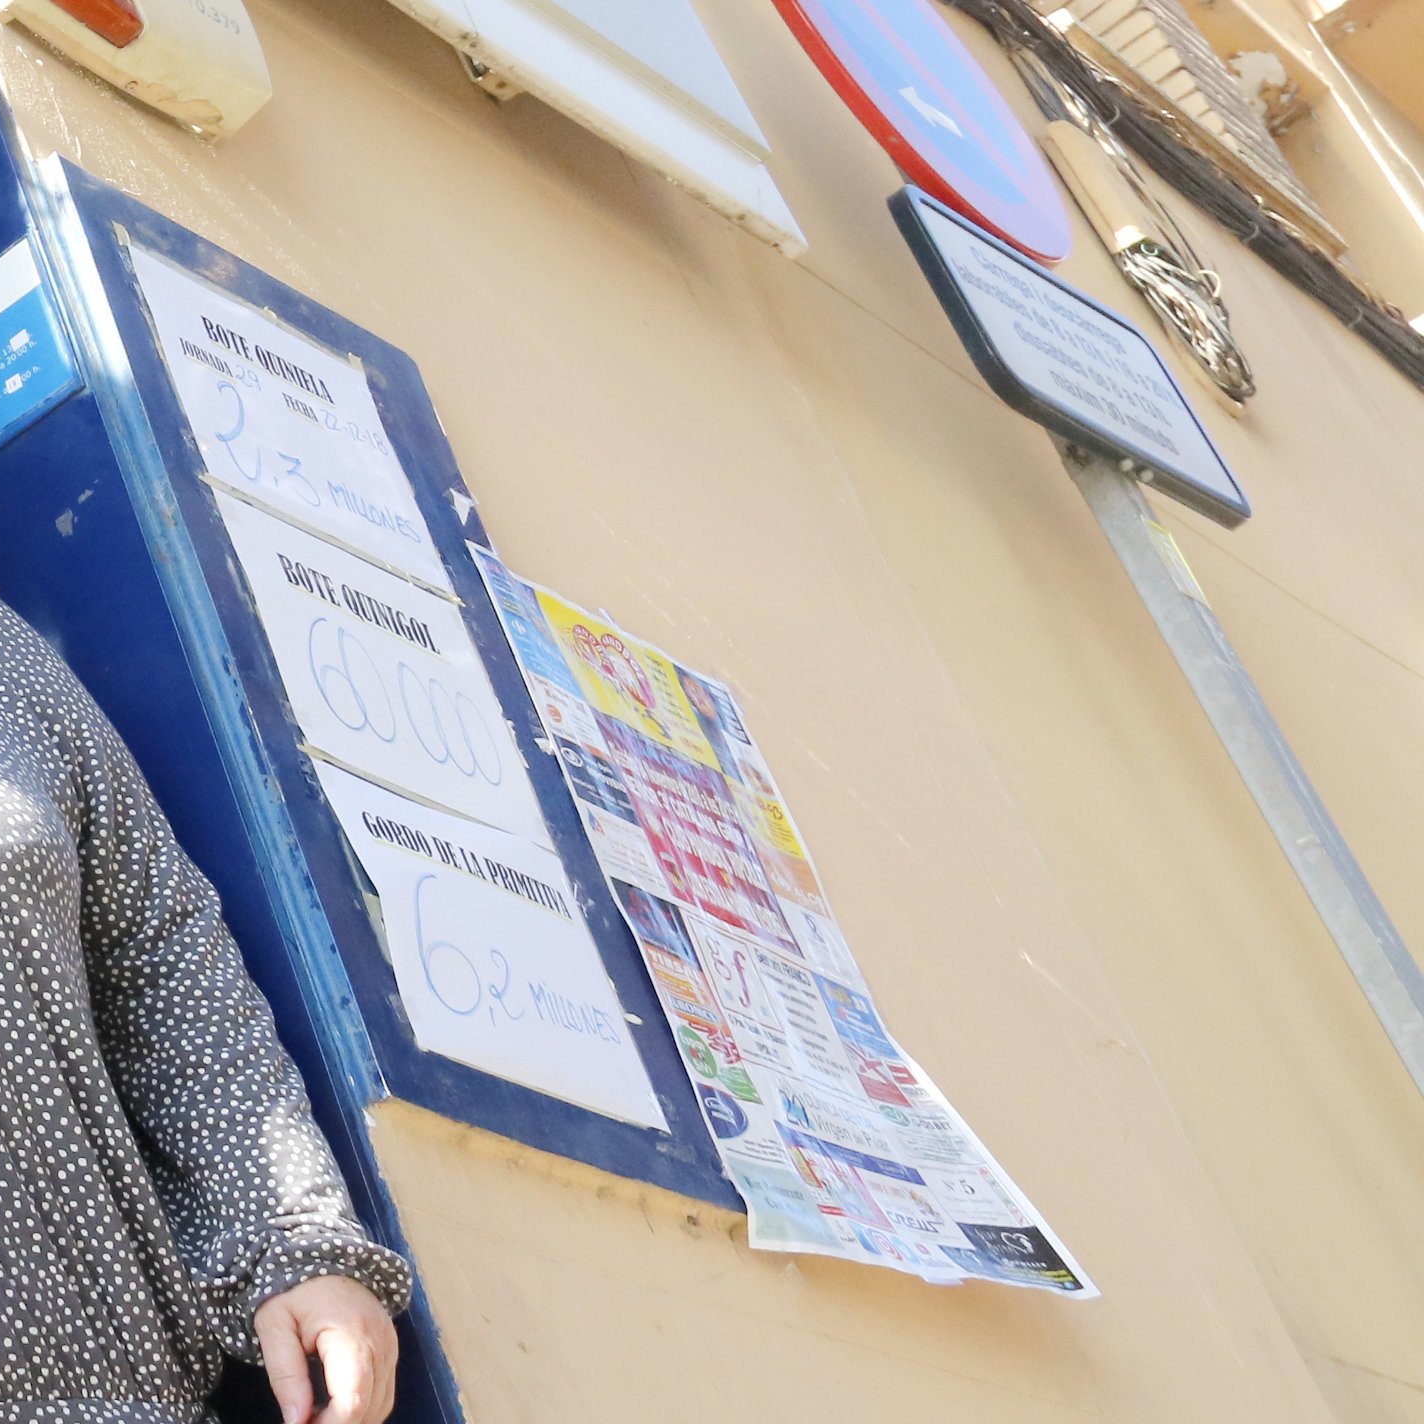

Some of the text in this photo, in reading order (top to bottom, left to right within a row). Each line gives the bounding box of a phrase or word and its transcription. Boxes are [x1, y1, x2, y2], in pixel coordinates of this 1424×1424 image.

[179, 336, 233, 377] JORNADA
[201, 315, 335, 405] BOTE QUINIELA
[282, 392, 320, 422] FECHA
[277, 552, 341, 607] BOTE
[342, 584, 441, 655] QUINIGOL
[361, 809, 574, 921] GORDO DE LA PRIMITIVA
